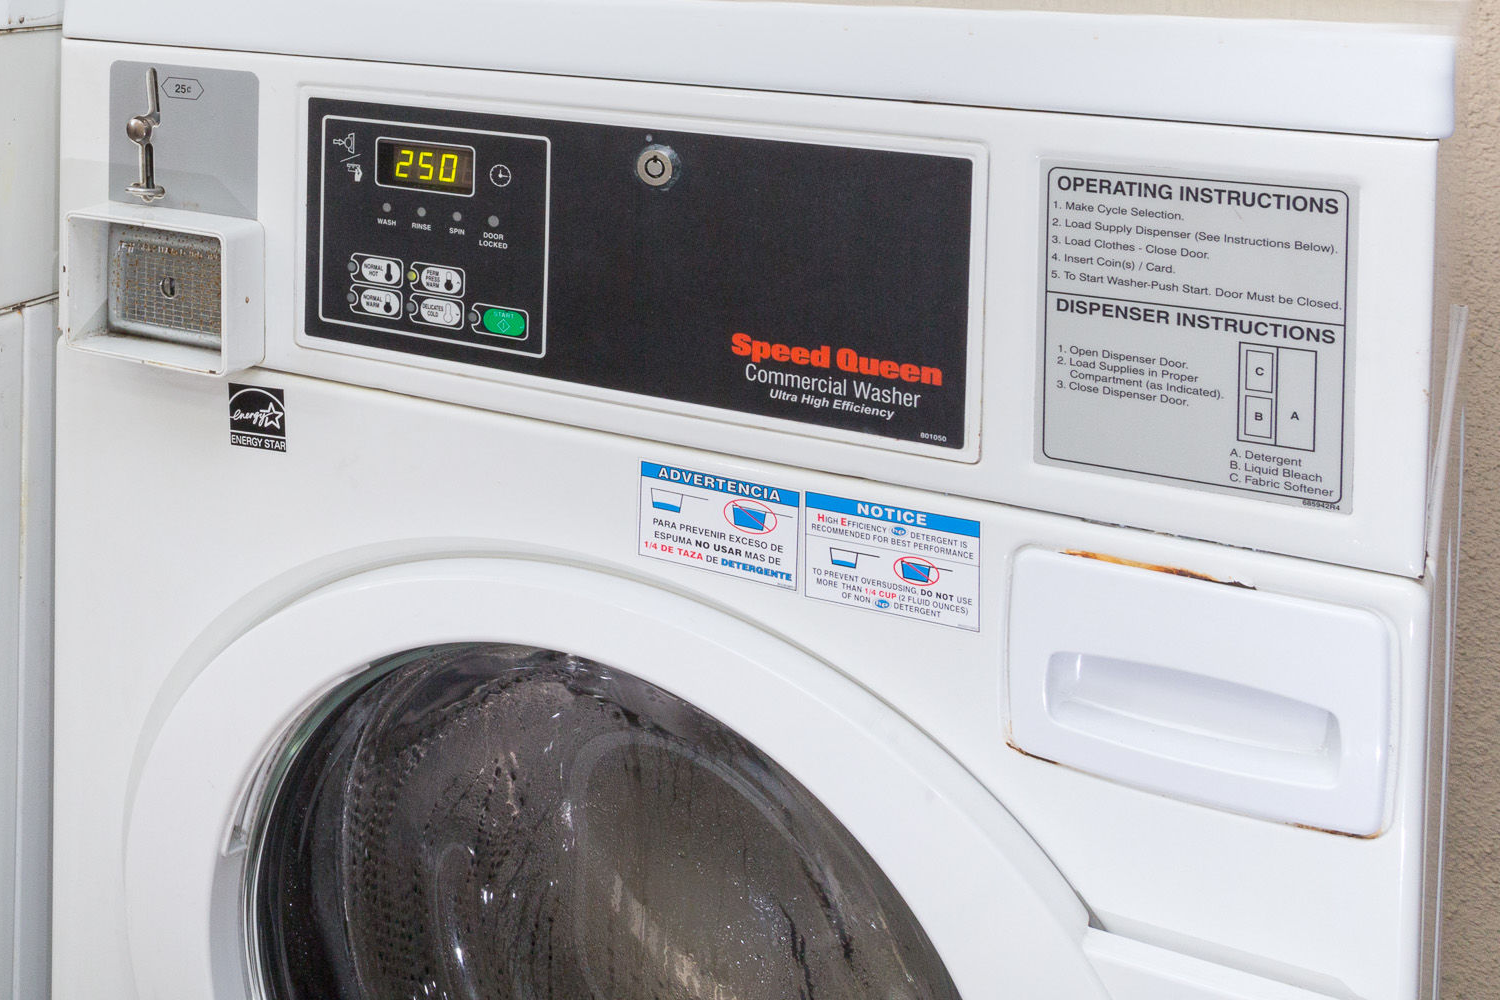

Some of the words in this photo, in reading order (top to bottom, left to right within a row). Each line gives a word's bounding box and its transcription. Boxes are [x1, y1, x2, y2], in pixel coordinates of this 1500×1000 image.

[396, 150, 458, 182] 250
[1057, 175, 1172, 200] OPERATING
[1179, 185, 1338, 214] INSTRUCTIONS
[377, 218, 396, 226] WASH
[1053, 200, 1062, 209] 1.
[1065, 200, 1094, 212] Make
[1097, 203, 1128, 216] Cycle
[1130, 207, 1184, 221] Selection.
[411, 223, 432, 231] RINSE
[483, 232, 504, 240] DOOR
[1051, 217, 1061, 226] 2.
[1065, 218, 1092, 230] Load
[1094, 221, 1132, 236] Supply
[1135, 225, 1191, 239] Dispenser
[1194, 231, 1220, 242] (See
[1223, 233, 1290, 249] Instructions
[1294, 240, 1337, 255] Below).
[479, 240, 508, 249] LOCKED
[1051, 234, 1061, 244] 3.
[1064, 236, 1091, 247] Load
[1094, 238, 1135, 252] Clothes
[1145, 244, 1177, 256] Close
[1180, 247, 1209, 259] Door.
[1051, 252, 1061, 261] 4.
[1064, 253, 1094, 265] Insert
[1096, 256, 1135, 271] Coin(s)
[1145, 262, 1175, 274] Card.
[363, 294, 382, 302] NORMAL
[1051, 269, 1060, 279] 5.
[1063, 270, 1076, 281] To
[1078, 272, 1104, 284] Start
[1106, 275, 1179, 292] Washer-Push
[1182, 283, 1211, 296] Start.
[1215, 287, 1243, 299] Door
[1246, 291, 1275, 303] Must
[1278, 294, 1294, 305] be
[1296, 296, 1341, 310] Closed.
[422, 303, 444, 312] DELICATES
[493, 311, 514, 319] START
[1056, 298, 1169, 324] DISPENSER
[1176, 312, 1335, 344] INSTRUCTIONS
[732, 333, 830, 368] Speed
[836, 348, 943, 386] Queen
[1255, 366, 1264, 376] C
[745, 363, 846, 397] Commercial
[853, 380, 921, 409] Washer
[770, 389, 798, 403] Ultra
[801, 393, 829, 410] High
[833, 398, 895, 420] Efficiency
[1254, 411, 1263, 421] B
[1290, 411, 1299, 421] A
[232, 435, 262, 446] ENERGY
[264, 439, 286, 450] STAR
[920, 432, 946, 443] 801050
[1229, 448, 1241, 458] A.
[1244, 449, 1302, 467] Detergent
[1229, 459, 1241, 470] B.
[1244, 462, 1279, 476] Liquid
[1282, 468, 1322, 483] Bleach
[658, 467, 780, 502] ADVERTENCIA
[1229, 472, 1241, 483] C.
[1244, 474, 1280, 489] Fabric
[1283, 480, 1334, 497] Softener
[857, 502, 927, 526] NOTICE
[652, 517, 677, 530] PARA
[679, 523, 726, 540] PREVENIR
[728, 534, 768, 550] EXCESO
[770, 543, 783, 553] DE
[811, 522, 871, 540] RECOMMENDED
[872, 534, 888, 543] FOR
[890, 537, 911, 547] BEST
[913, 541, 973, 560] PERFORMANCE
[817, 513, 838, 524] HIGH
[840, 517, 886, 533] EFFICIENCY
[910, 531, 957, 546] DETERGENT
[643, 539, 658, 550] 1/4
[660, 543, 674, 554] DE
[677, 547, 704, 561] TAZA
[705, 554, 718, 565] DE
[721, 557, 792, 581] DETERGENTE
[654, 530, 692, 546] ESPUMA
[694, 539, 710, 549] NO
[713, 543, 742, 557] USAR
[744, 550, 765, 562] MAS
[768, 555, 780, 566] DE
